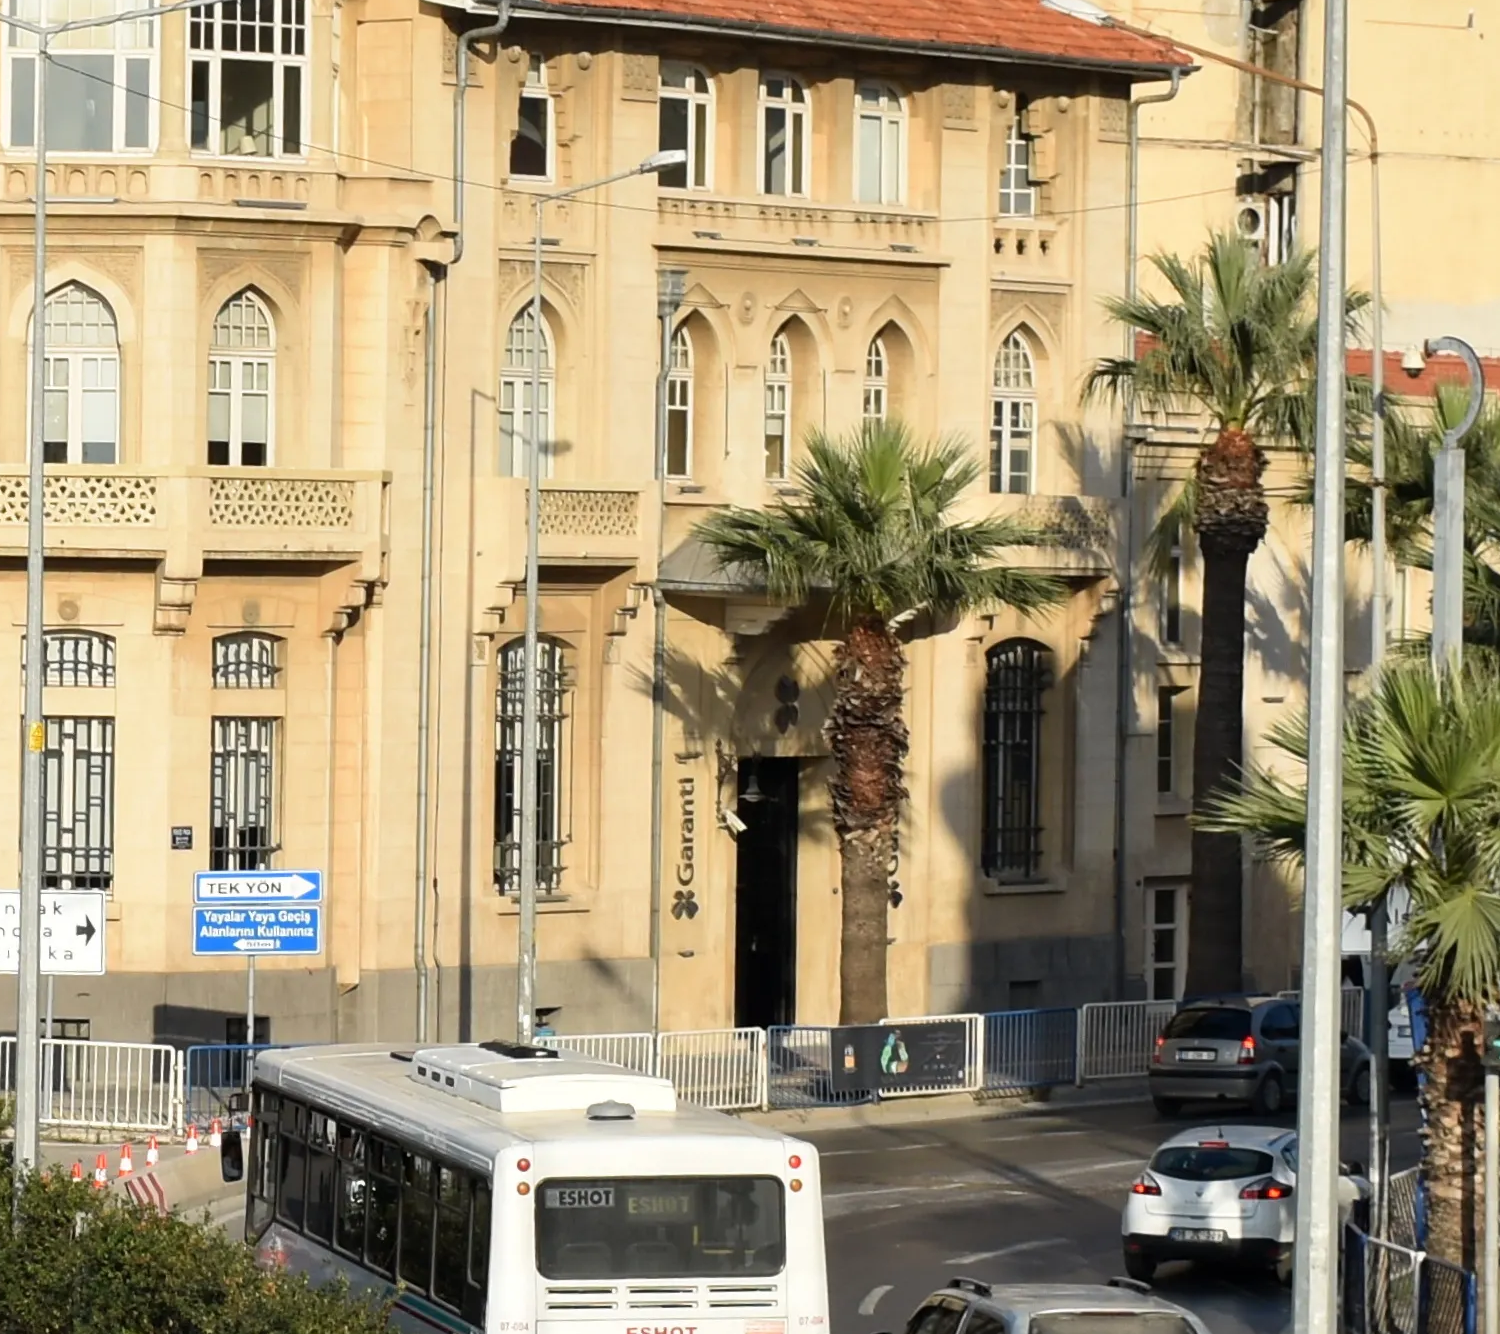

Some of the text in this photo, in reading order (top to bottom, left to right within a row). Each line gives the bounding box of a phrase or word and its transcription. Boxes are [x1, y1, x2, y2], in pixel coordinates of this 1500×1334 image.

[677, 777, 695, 886] Garanti
[207, 879, 282, 895] TEK YÖN
[203, 910, 312, 925] Yayalar Yaya Geçiş
[558, 1190, 612, 1206] ESHOT
[629, 1195, 690, 1214] ESHOT
